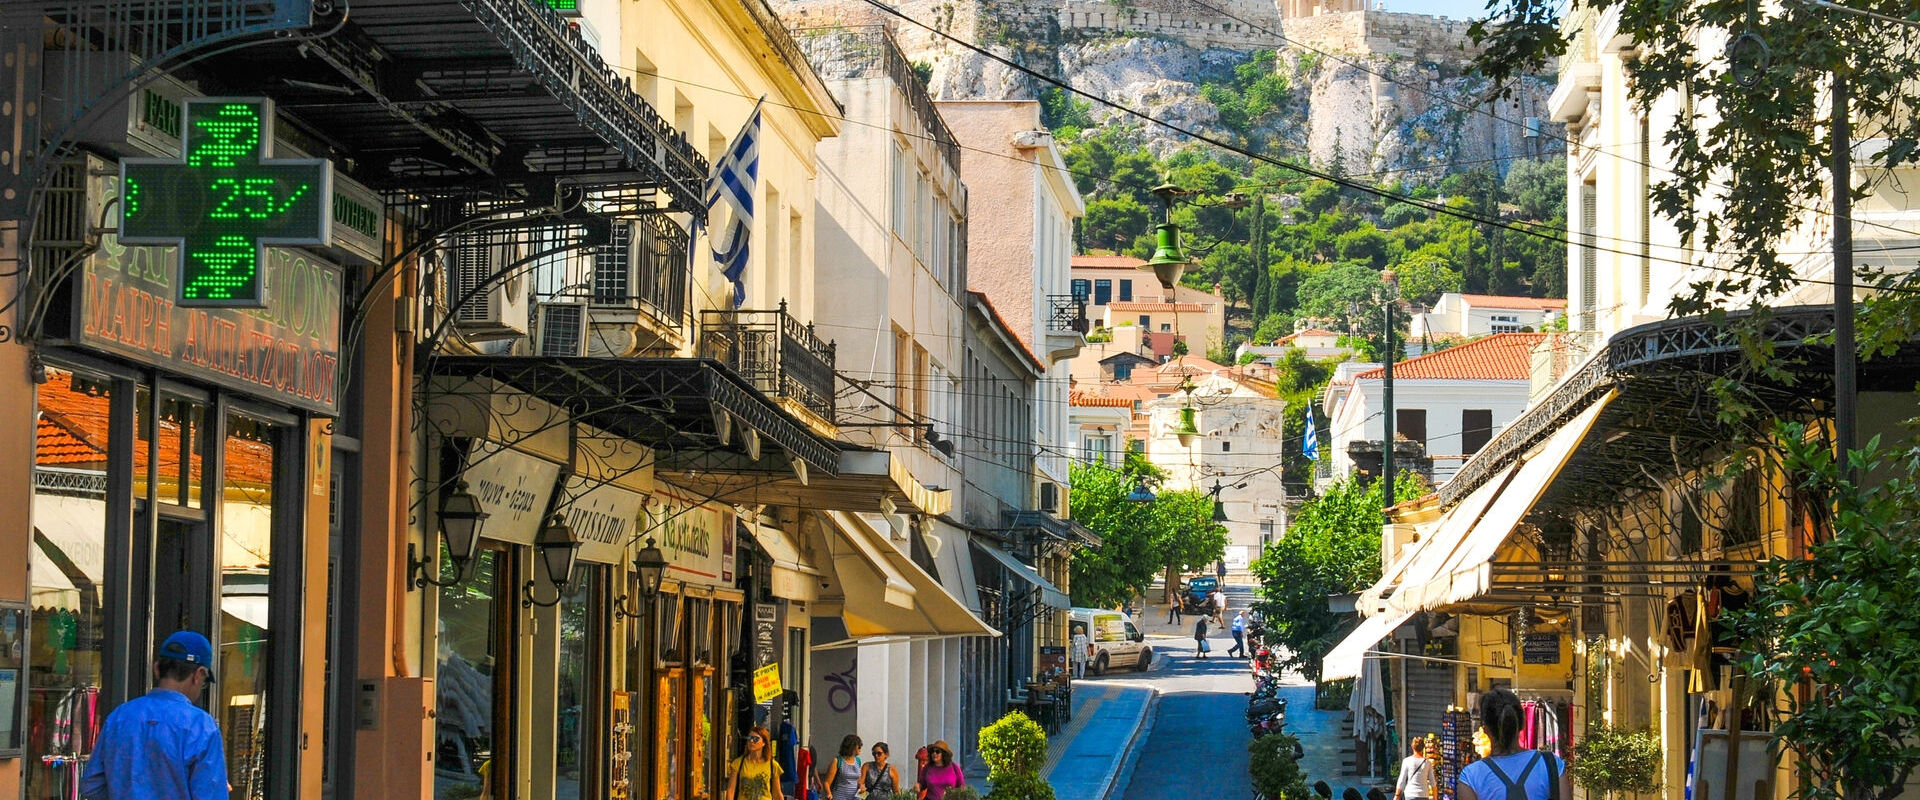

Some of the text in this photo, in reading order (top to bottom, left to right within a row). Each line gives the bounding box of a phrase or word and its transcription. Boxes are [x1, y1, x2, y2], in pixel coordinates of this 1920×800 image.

[144, 89, 181, 139] FAR
[86, 273, 337, 405] ΜΑΙΡΗ ΑΜΠΑΤΖΟΓΛΟΥ
